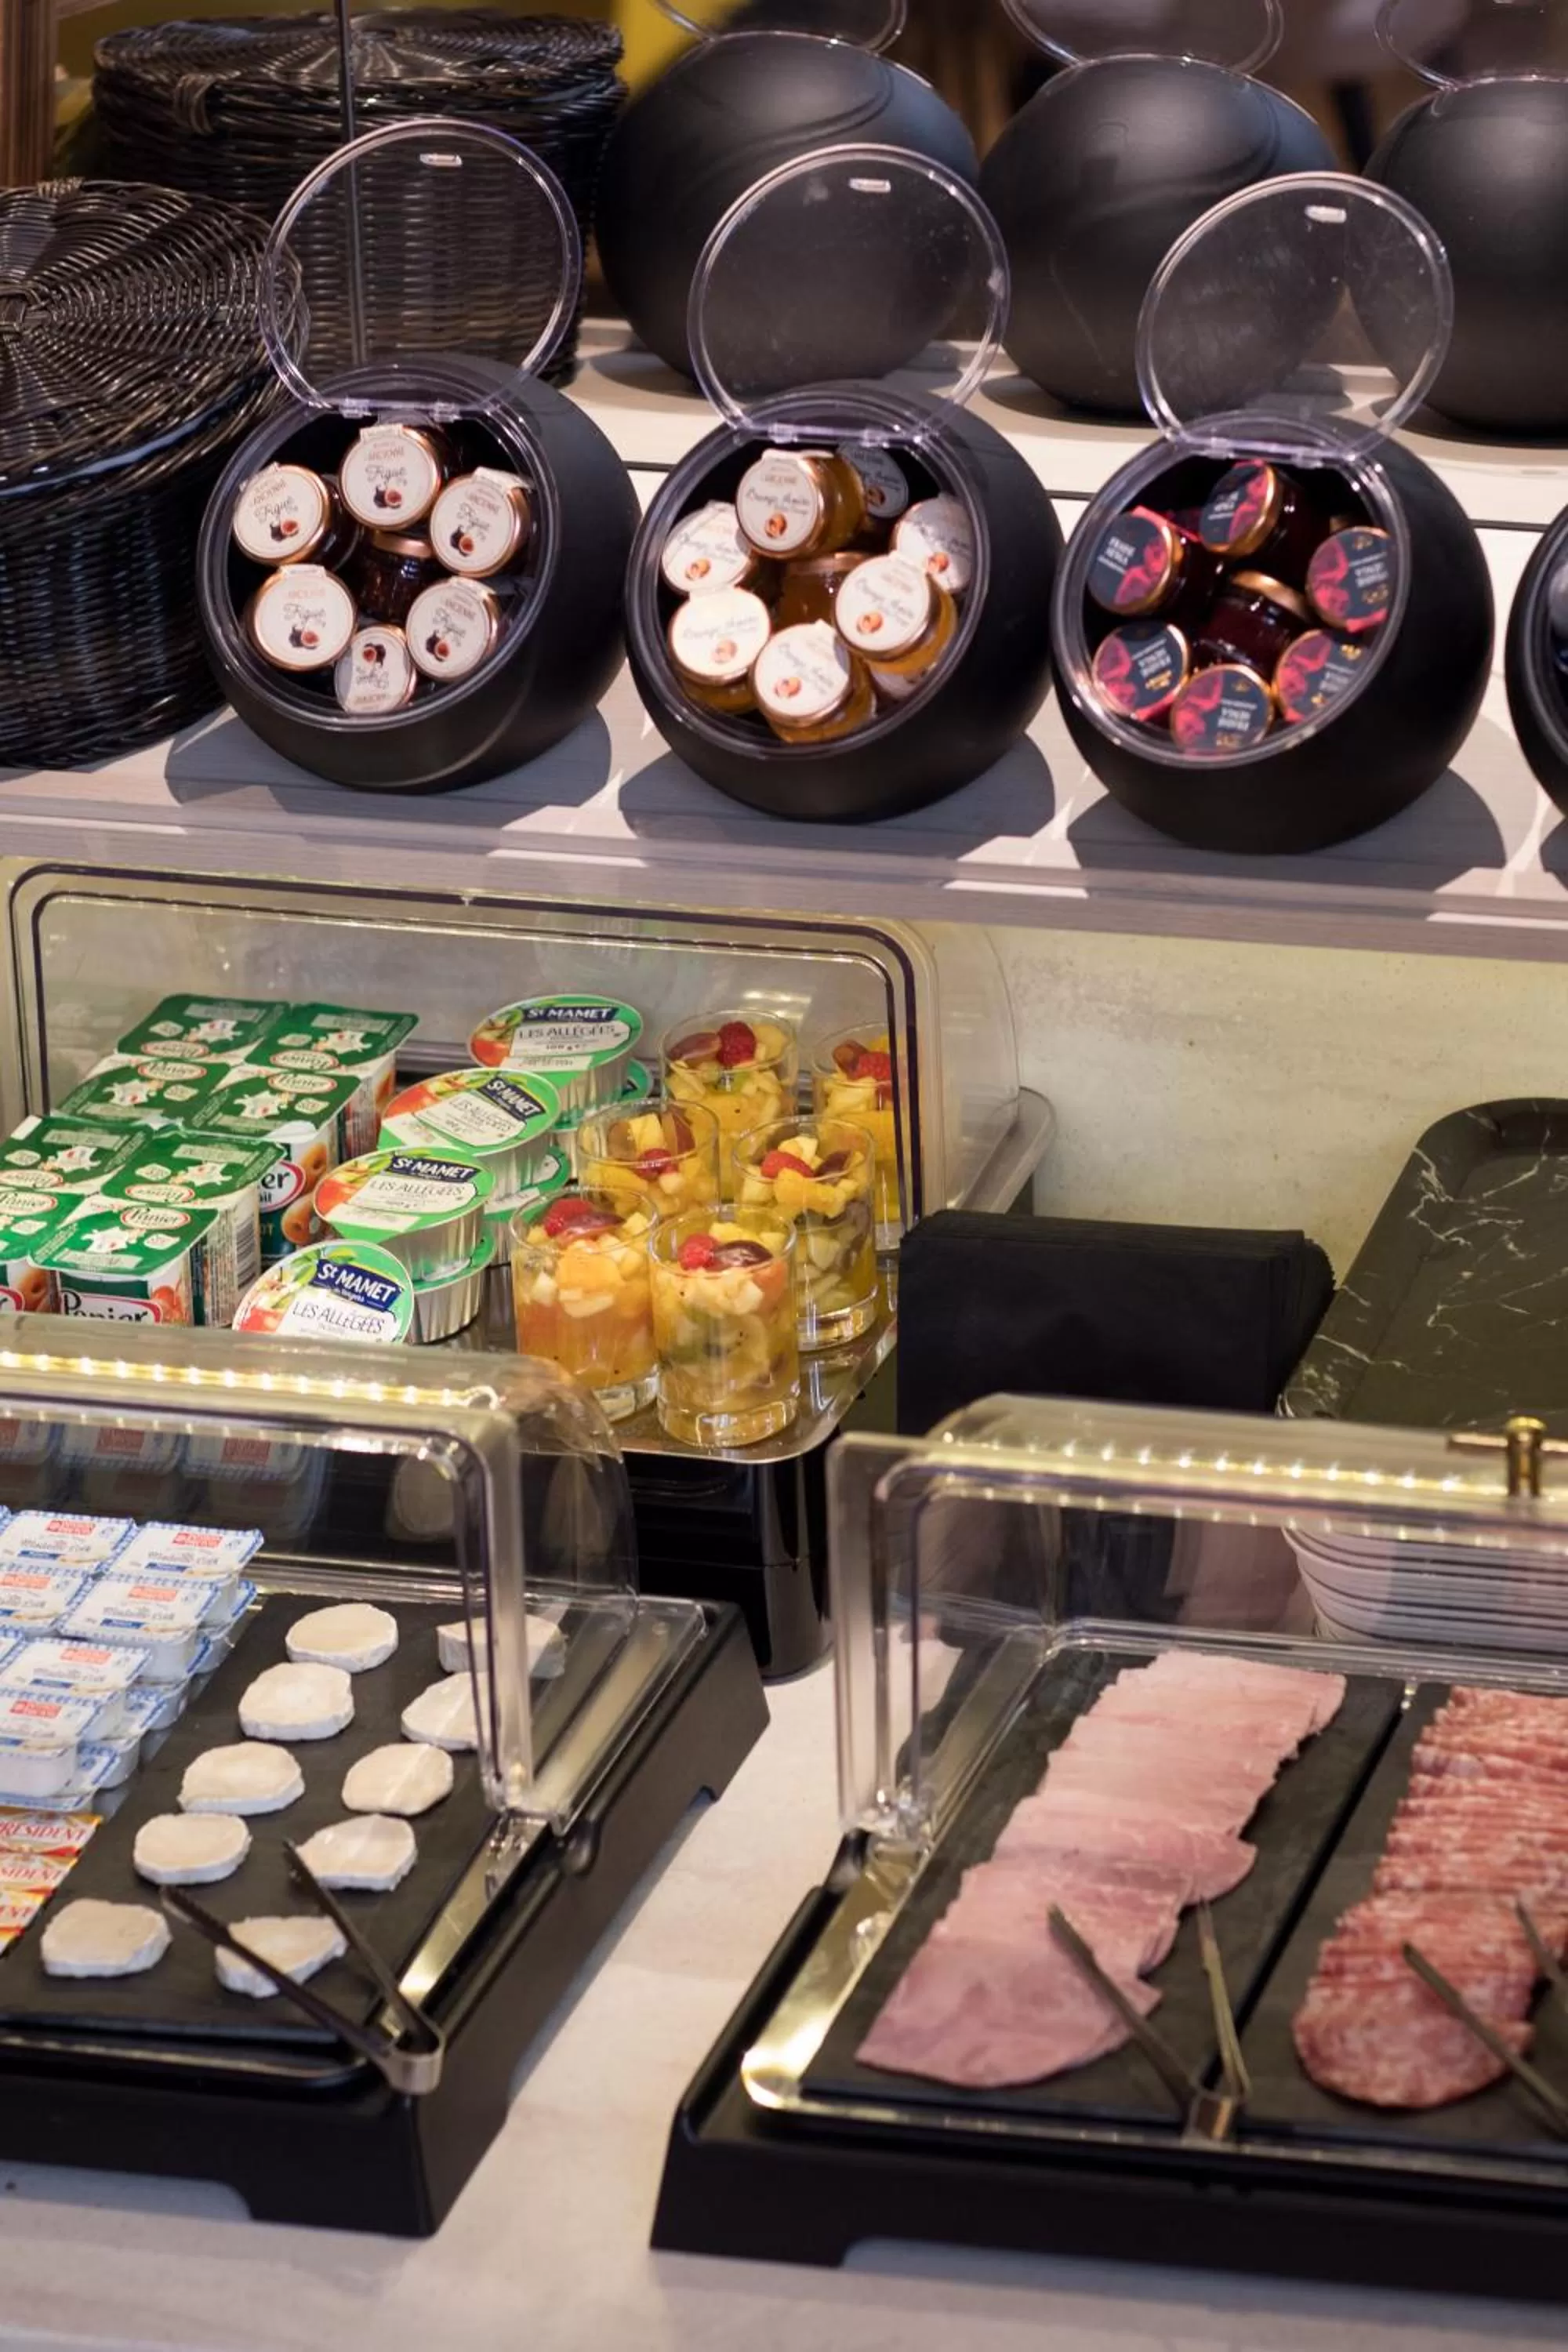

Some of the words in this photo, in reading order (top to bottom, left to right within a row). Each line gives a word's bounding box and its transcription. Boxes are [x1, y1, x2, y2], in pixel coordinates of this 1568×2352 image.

[547, 1007, 612, 1019] MAMET
[499, 1086, 541, 1116] MAMET
[393, 1157, 413, 1170] St
[412, 1160, 475, 1179] MAMET
[318, 1263, 339, 1281] St
[335, 1269, 397, 1302] MAMET
[292, 1301, 318, 1319] LES
